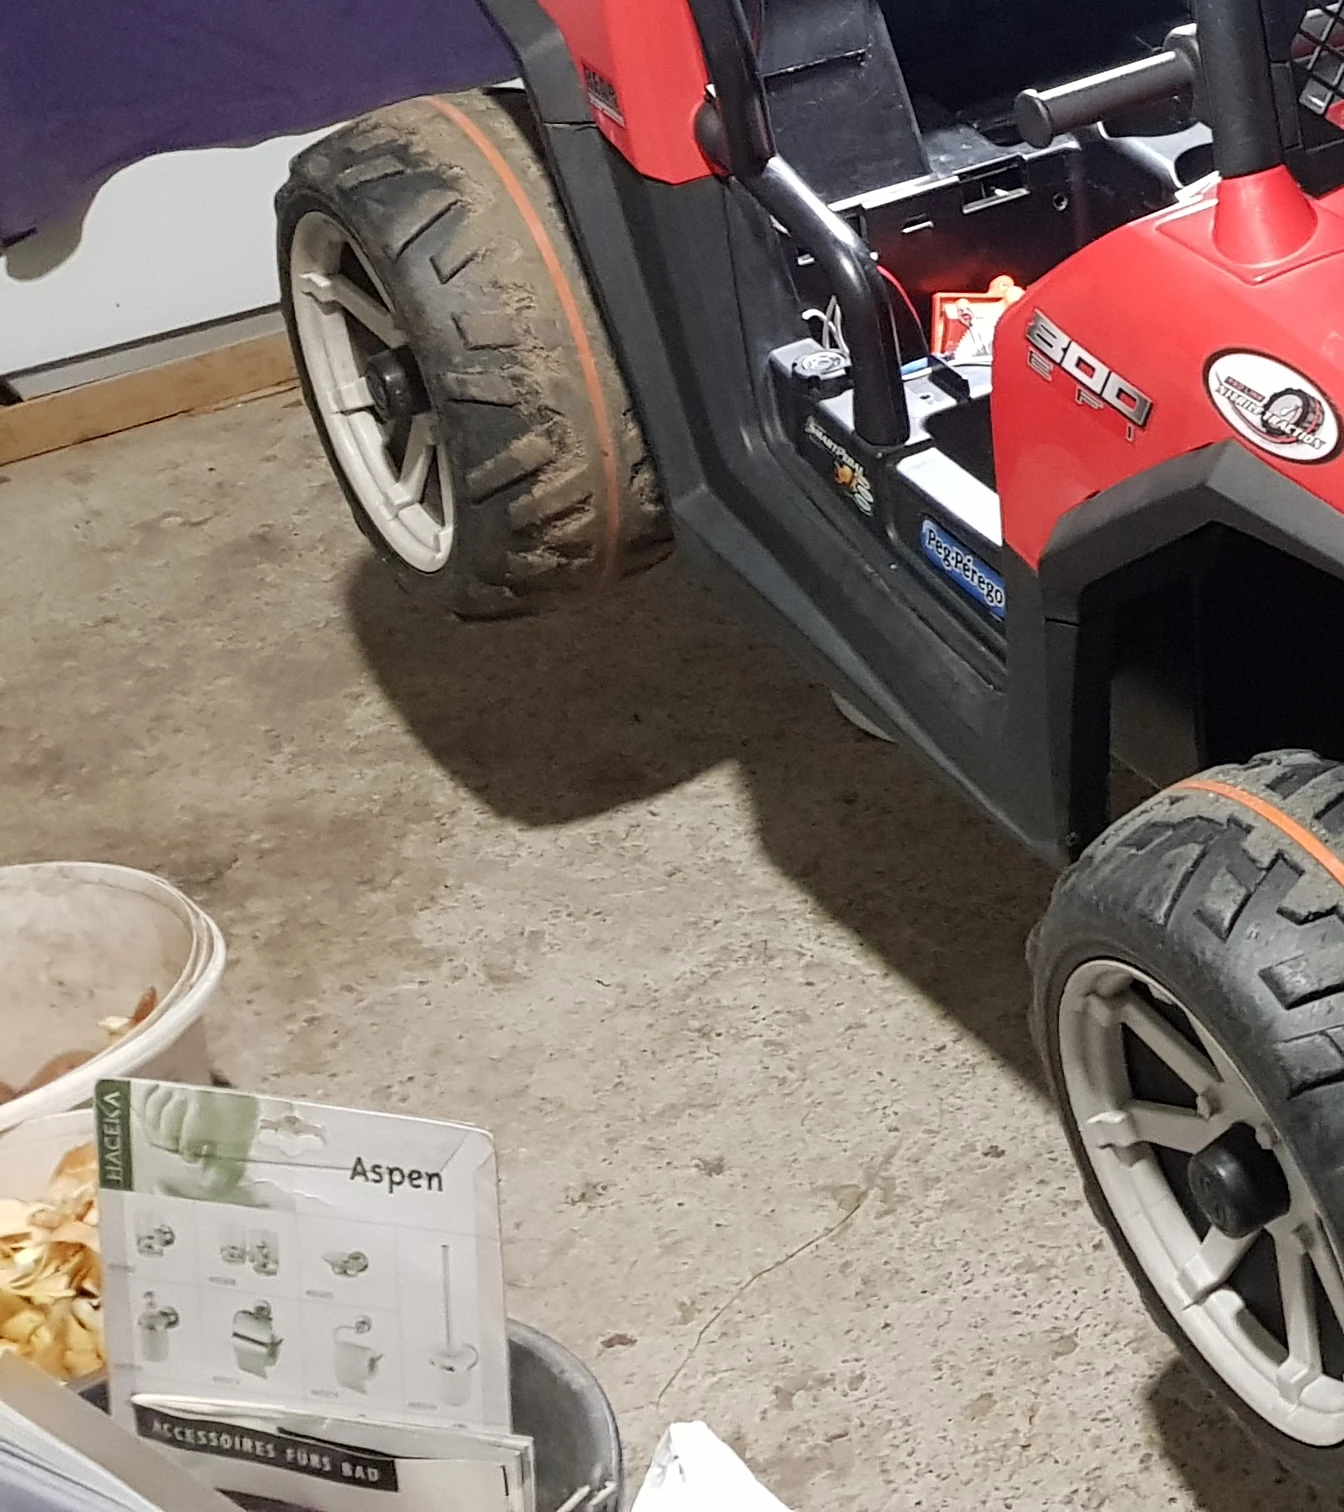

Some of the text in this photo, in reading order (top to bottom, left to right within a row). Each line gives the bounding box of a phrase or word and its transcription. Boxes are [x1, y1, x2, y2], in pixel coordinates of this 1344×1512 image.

[1026, 307, 1153, 427] 800
[1263, 410, 1326, 450] TRACTION
[104, 1090, 122, 1184] HACEKA
[349, 1156, 444, 1193] Aspen
